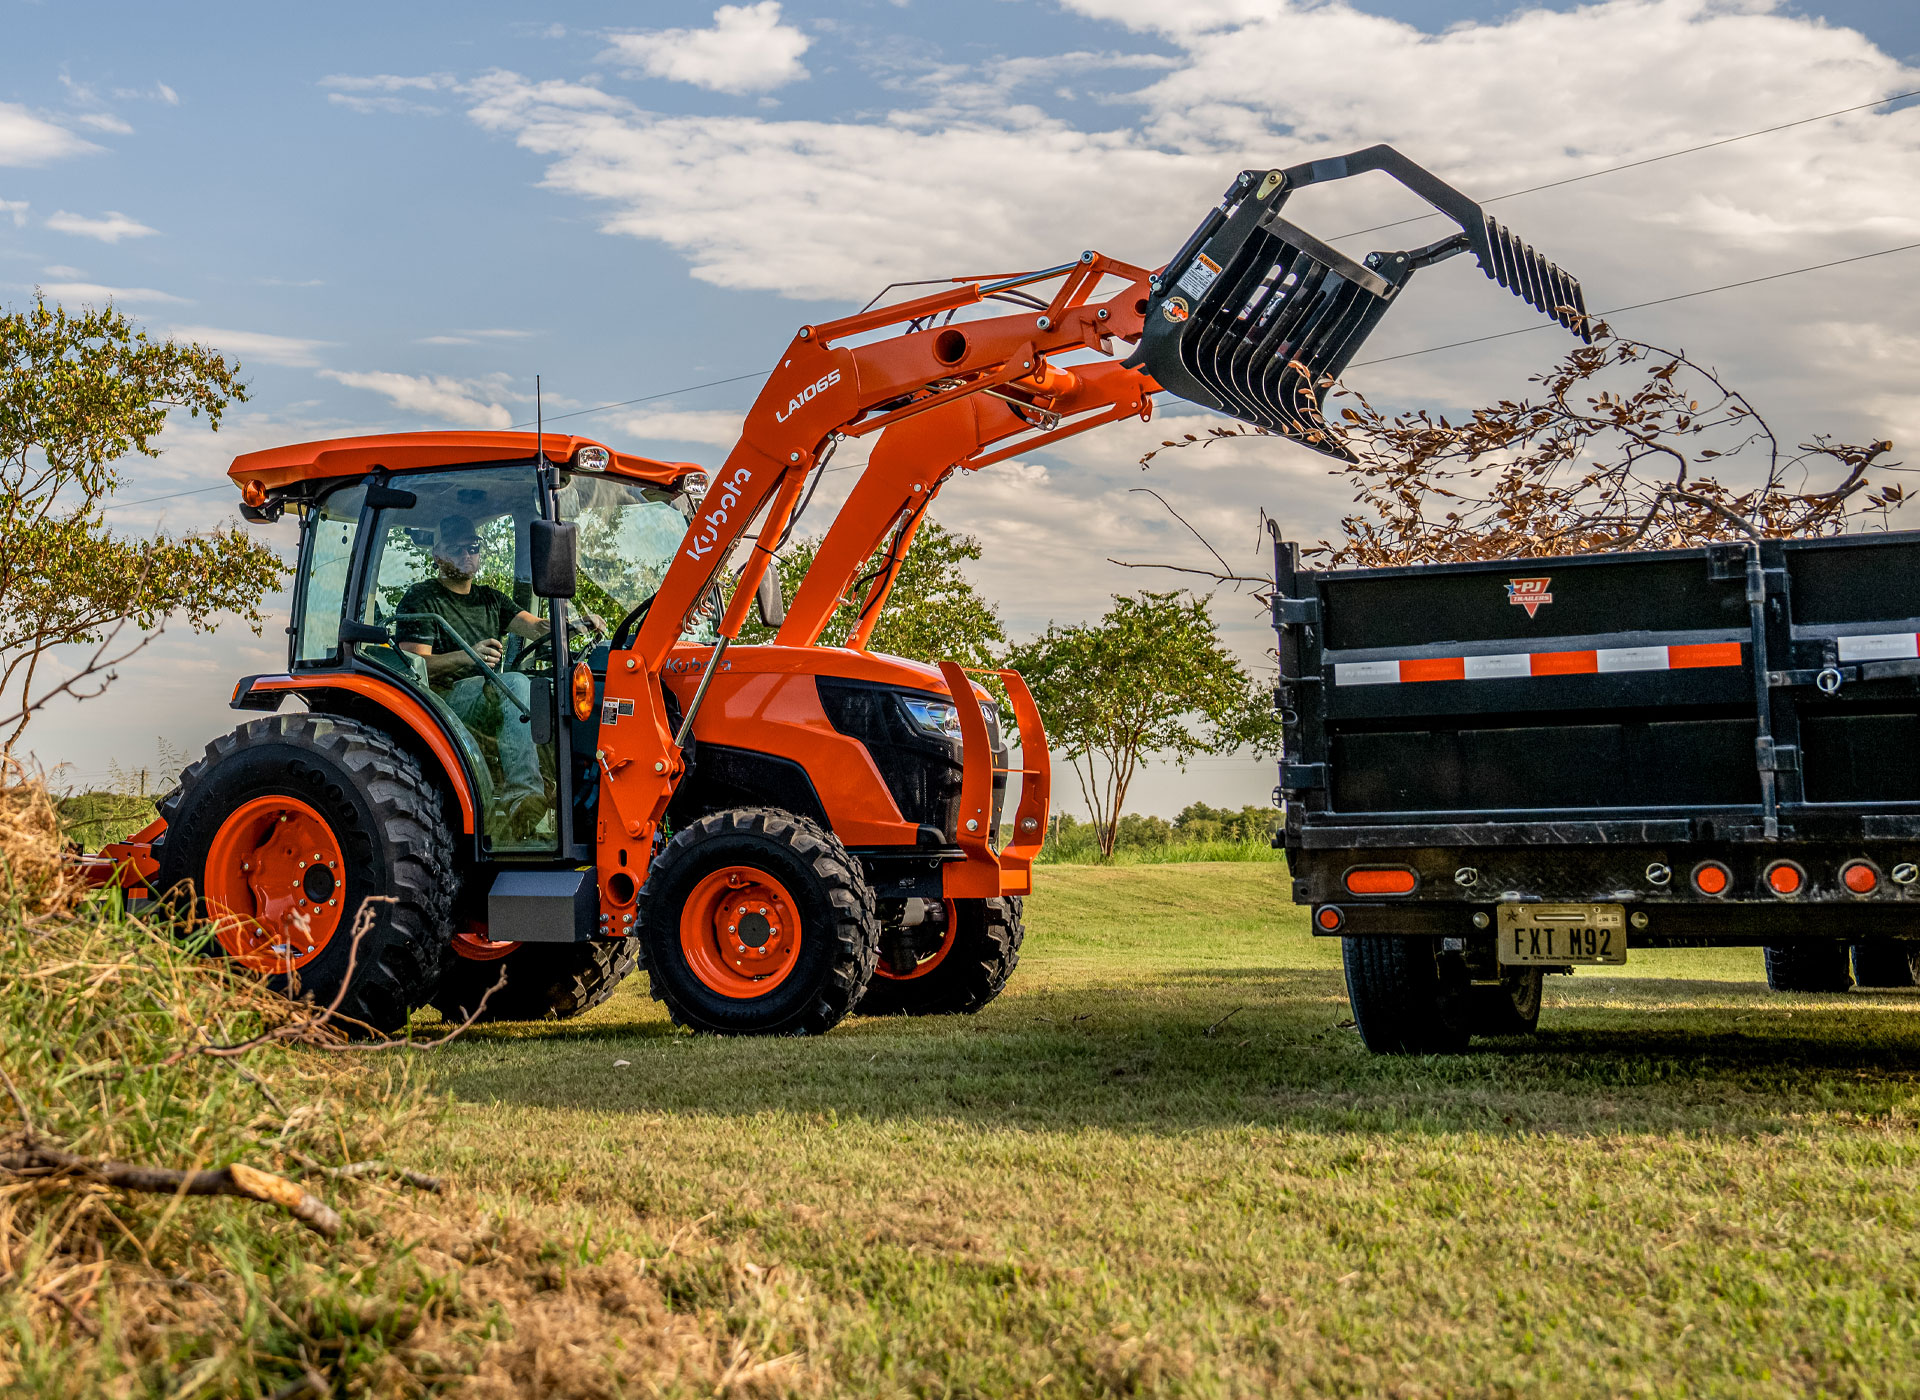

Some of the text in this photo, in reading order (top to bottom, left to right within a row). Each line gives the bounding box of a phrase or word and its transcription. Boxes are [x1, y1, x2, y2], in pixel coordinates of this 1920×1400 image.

[775, 368, 841, 423] LA1065
[686, 467, 752, 561] Kubota
[1520, 581, 1541, 593] PJ
[666, 657, 731, 673] Kuba
[1514, 928, 1612, 956] FXT M92
